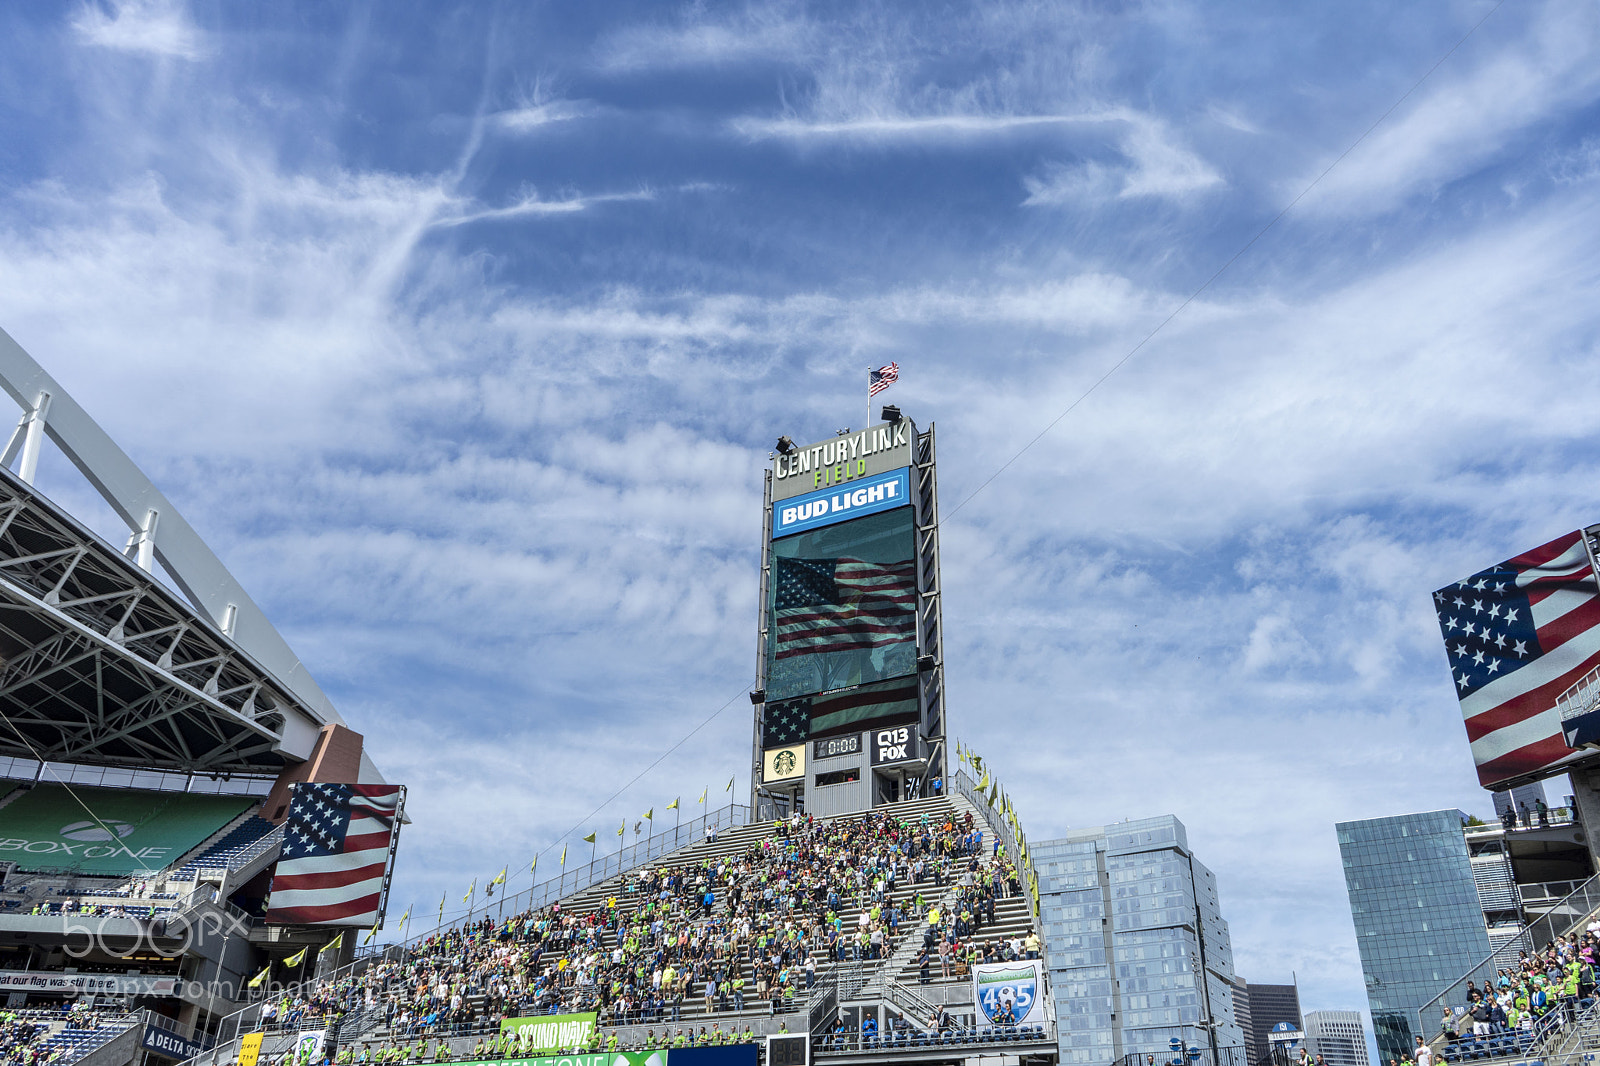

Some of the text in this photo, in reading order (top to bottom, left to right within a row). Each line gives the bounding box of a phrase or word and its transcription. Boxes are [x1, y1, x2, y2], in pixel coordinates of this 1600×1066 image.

[776, 421, 907, 480] CENTURYLINK
[813, 459, 866, 487] FIELD
[782, 480, 899, 525] BUD LIGHT
[828, 738, 857, 755] 0:00
[878, 728, 909, 746] Q13
[880, 744, 908, 762] FOX
[0, 838, 172, 859] BOX ONE
[0, 976, 10, 985] at
[12, 977, 29, 985] our
[30, 976, 48, 988] flag
[50, 978, 66, 987] was
[70, 977, 86, 987] still
[156, 1034, 185, 1054] DELTA
